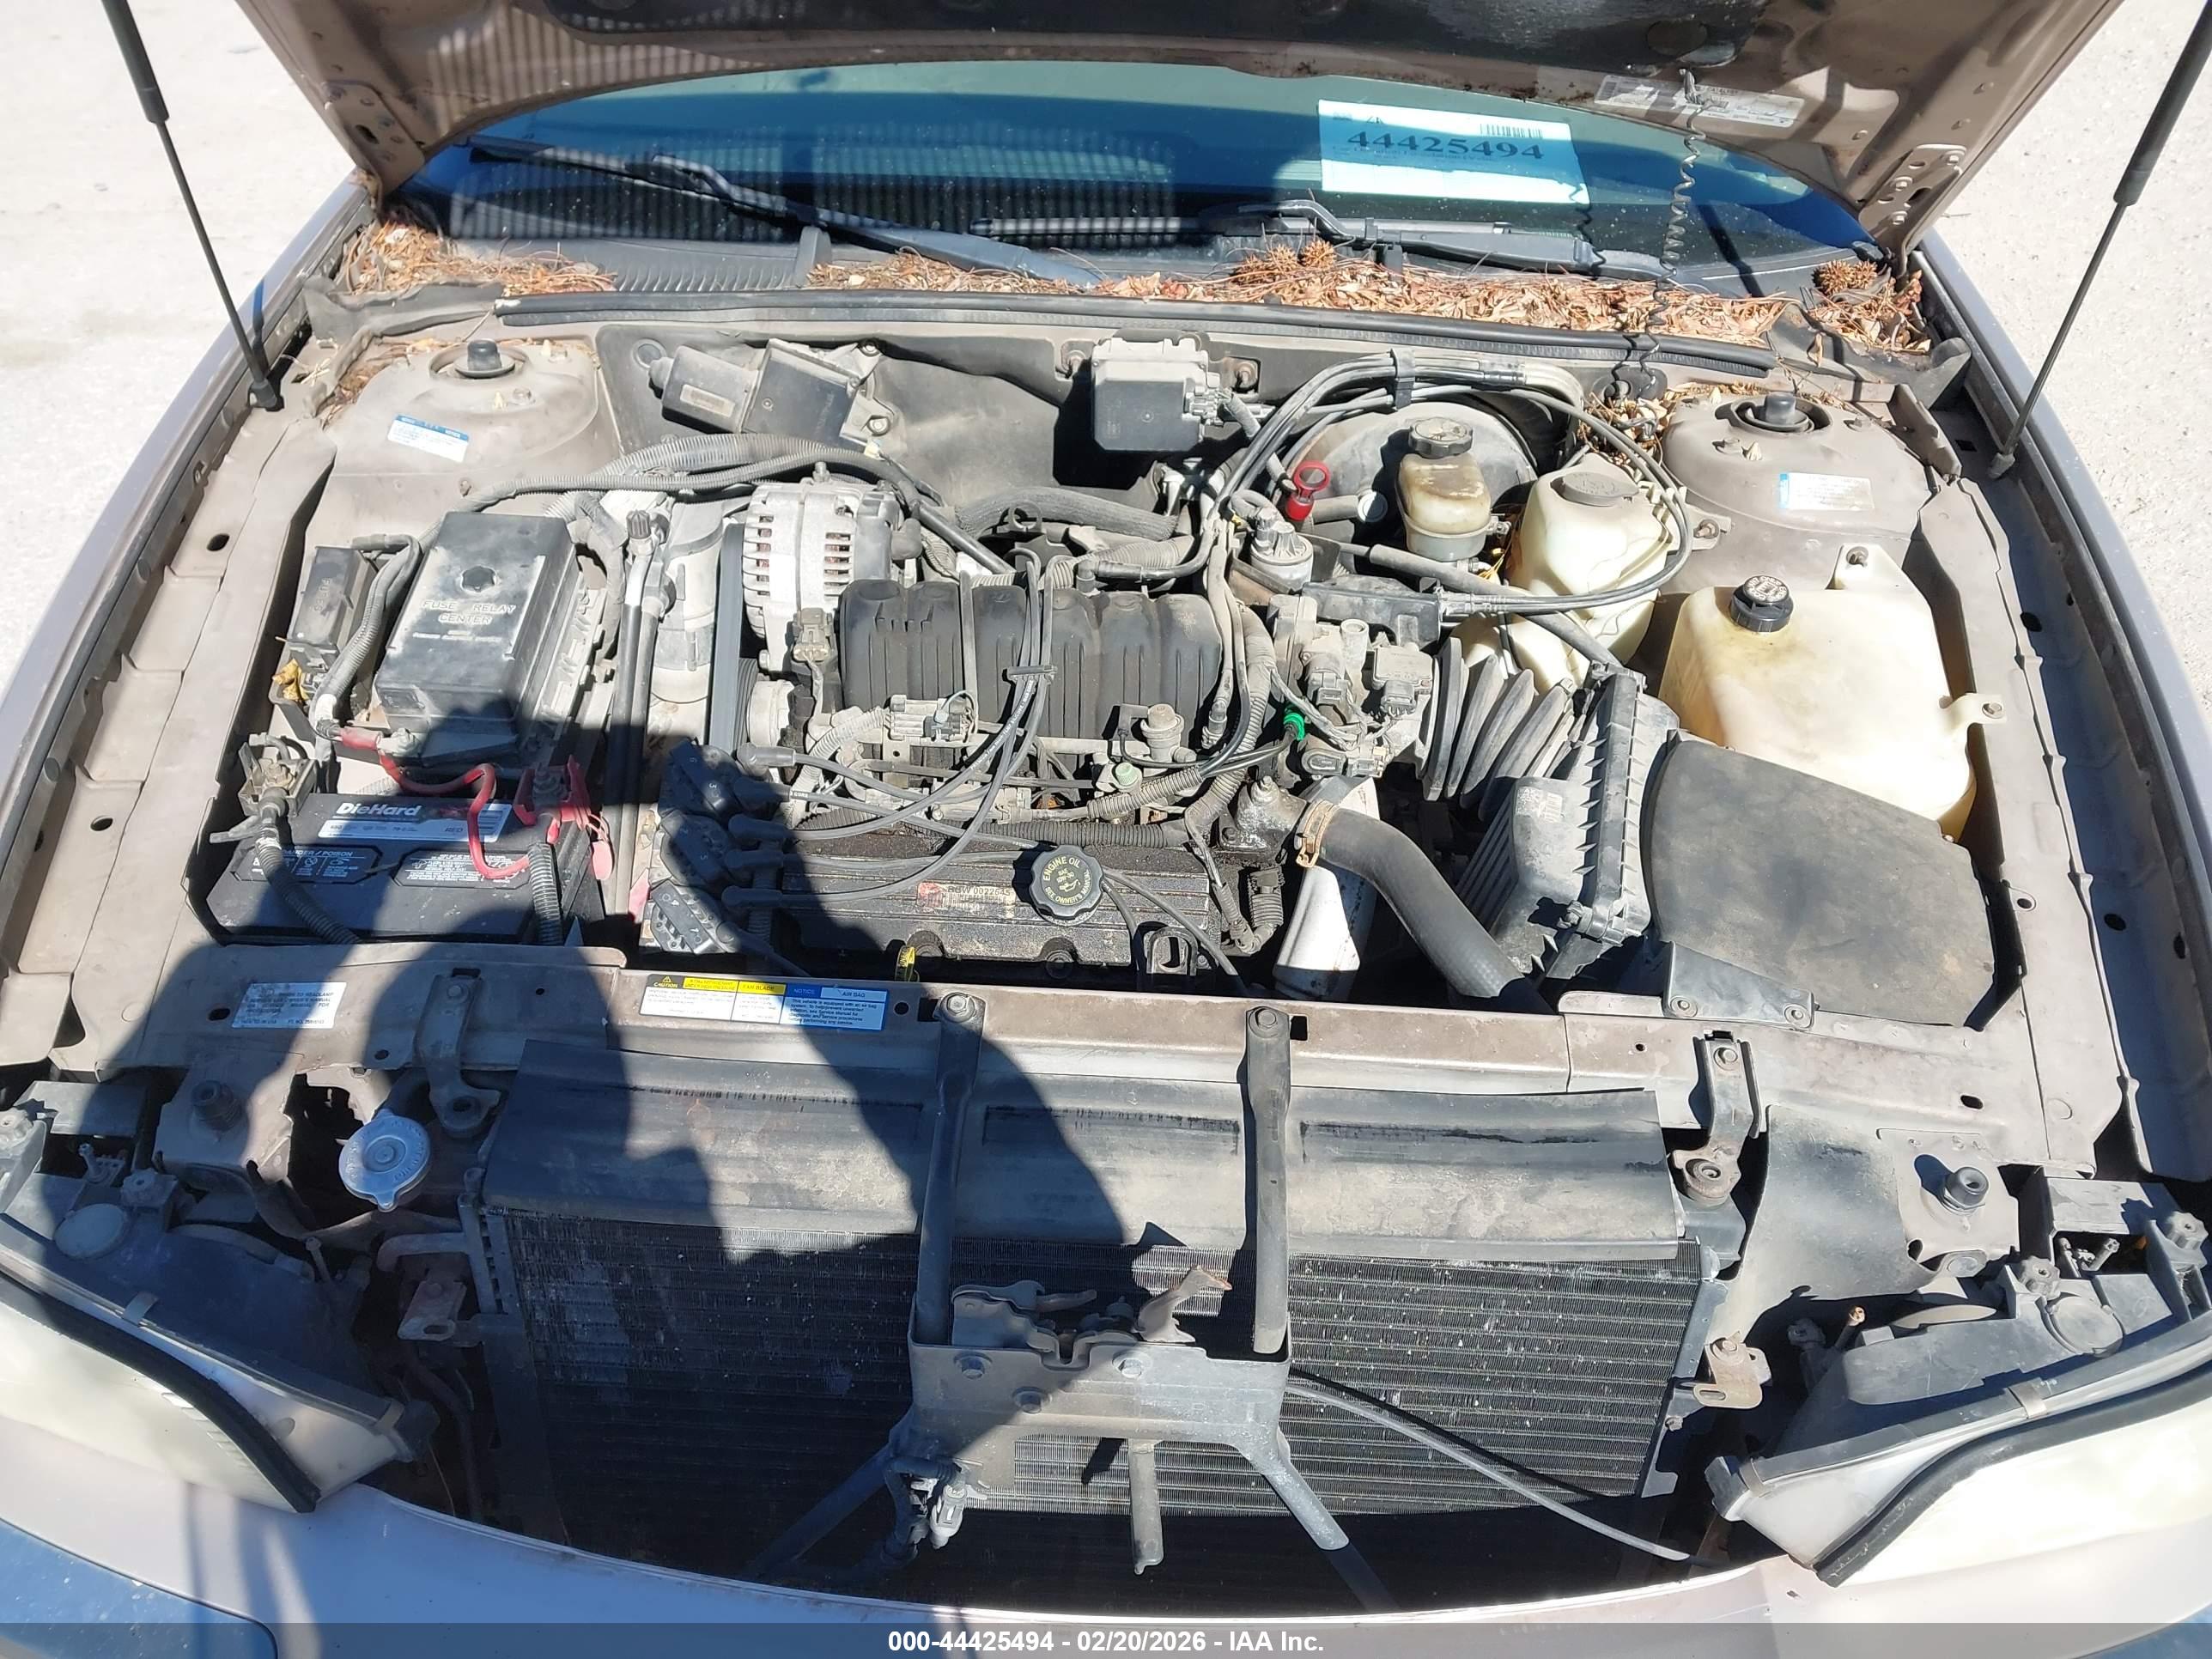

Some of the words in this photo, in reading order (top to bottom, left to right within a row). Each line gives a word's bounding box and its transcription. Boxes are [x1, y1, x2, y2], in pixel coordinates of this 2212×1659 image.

[1348, 131, 1544, 159] 44425494
[423, 601, 457, 610] FUSE
[474, 604, 515, 613] RELAY
[440, 614, 492, 624] CENTER
[336, 803, 422, 816] DieHard
[1043, 856, 1067, 881] ENGINE
[1069, 857, 1080, 868] OIL
[1045, 886, 1056, 898] SEE
[1055, 893, 1082, 904] OWNER'S
[1081, 869, 1091, 896] MANUAL
